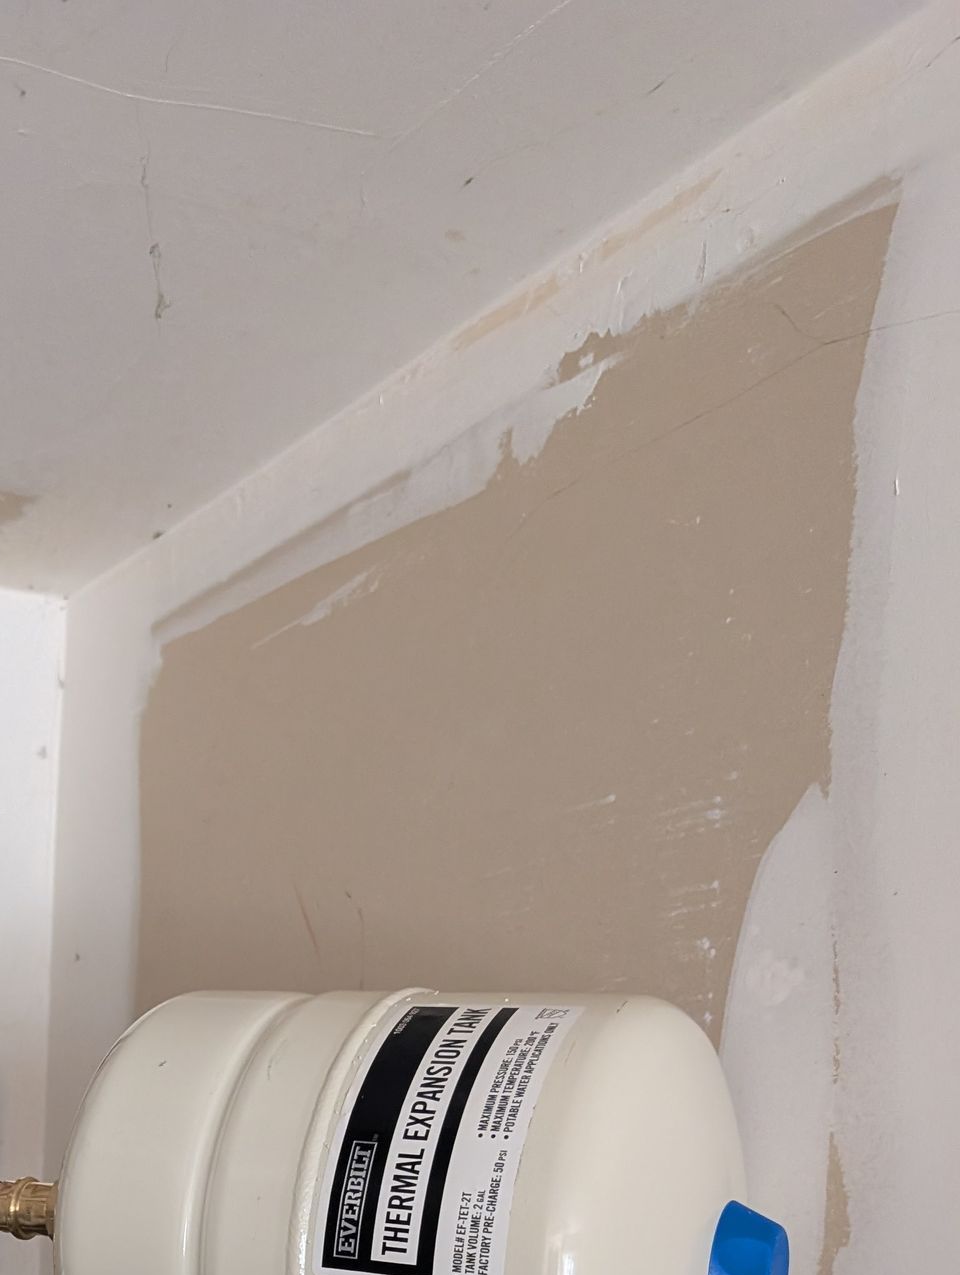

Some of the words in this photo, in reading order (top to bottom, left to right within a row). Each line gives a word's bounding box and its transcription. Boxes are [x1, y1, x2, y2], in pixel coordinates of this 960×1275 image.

[478, 1095, 497, 1131] MAXIMUM
[490, 1058, 513, 1094] PRESSURE:
[490, 1095, 510, 1132] MAXIMUM
[502, 1048, 531, 1094] TEMPERATURE:
[503, 1099, 522, 1132] POTABLE
[514, 1075, 532, 1098] WATER
[524, 1034, 551, 1074] APPLICATIONS
[381, 1148, 425, 1255] THERMAL
[403, 1039, 468, 1141] EXPANSION
[447, 1008, 492, 1036] TANK
[493, 1162, 505, 1173] 50
[498, 1150, 508, 1161] PSI
[338, 1145, 372, 1254] EVERBILT
[456, 1192, 472, 1235] EF-TET-2T
[477, 1190, 486, 1203] GAL
[483, 1175, 502, 1234] PRE-CHARGE:
[468, 1212, 482, 1250] VOLUME:
[452, 1237, 465, 1273] MODEL#
[465, 1252, 476, 1274] TANK
[478, 1236, 492, 1275] FACTORY
